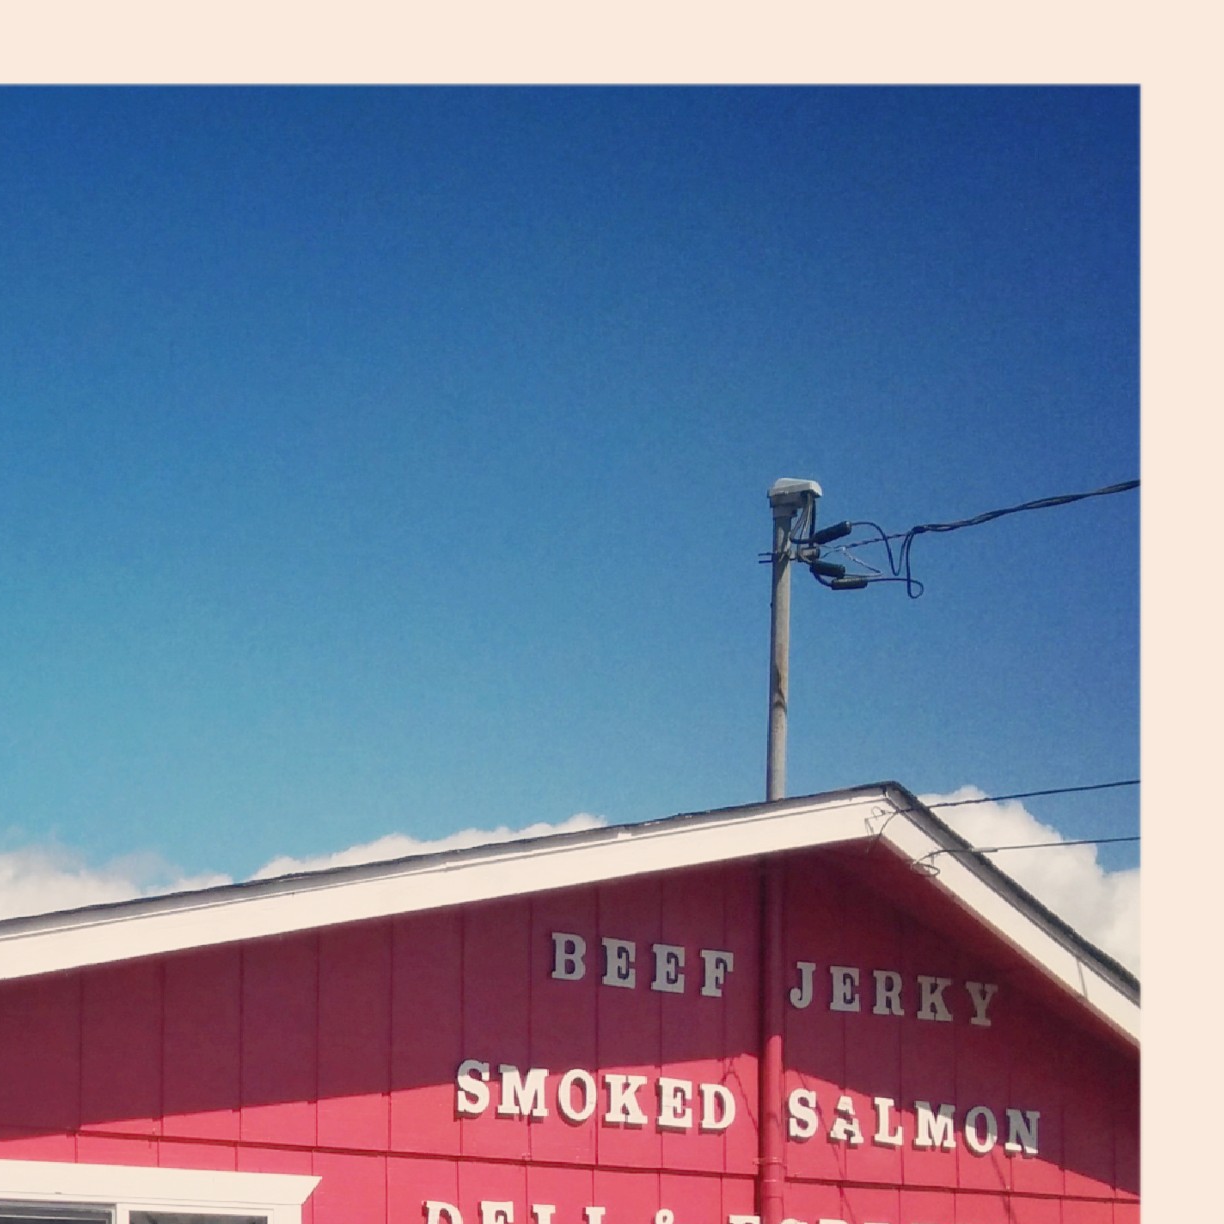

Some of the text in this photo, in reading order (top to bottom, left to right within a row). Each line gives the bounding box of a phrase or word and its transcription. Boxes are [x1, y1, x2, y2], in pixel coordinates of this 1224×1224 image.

[551, 931, 999, 1027] BEEF JERKY
[456, 1058, 1041, 1155] SMOKED SALMON
